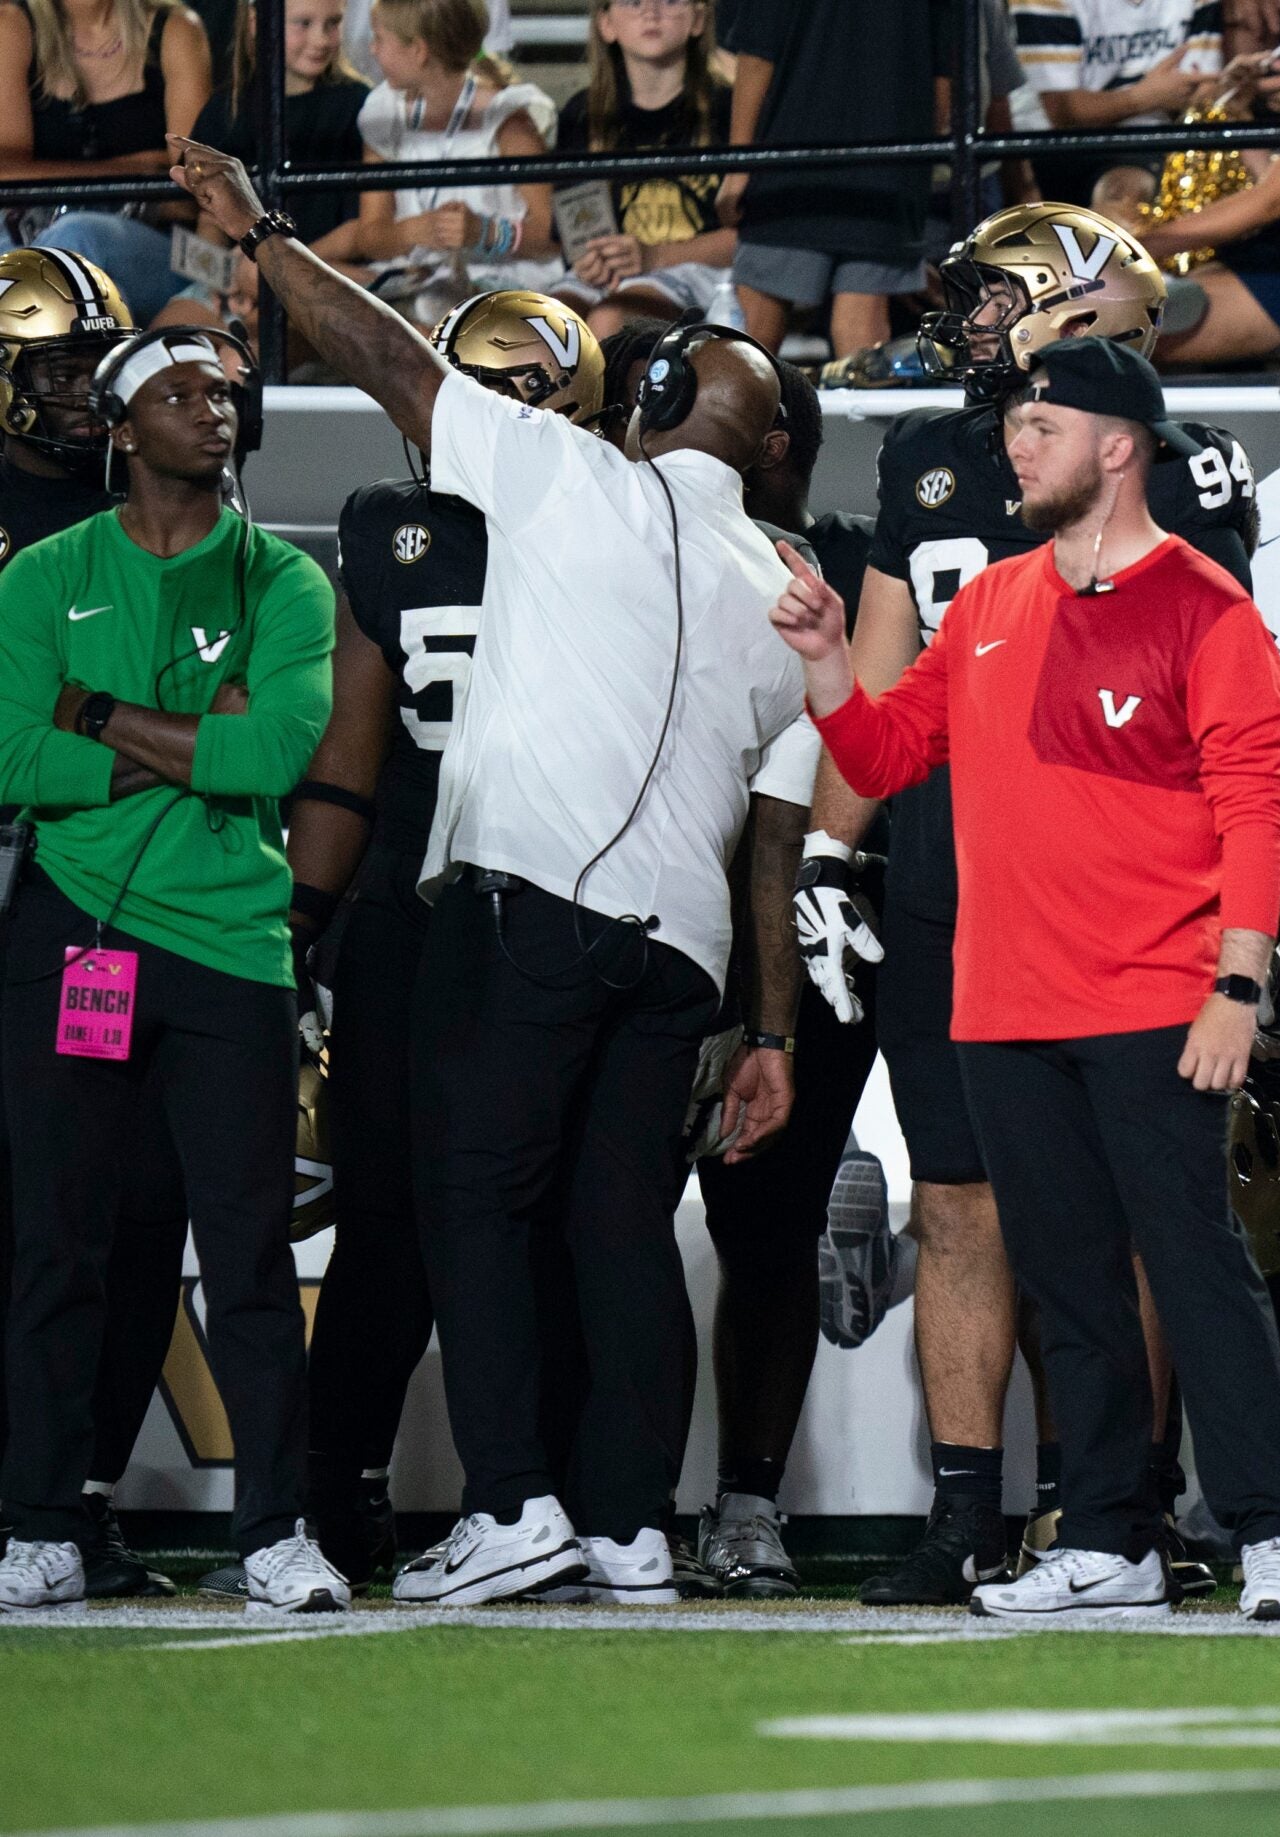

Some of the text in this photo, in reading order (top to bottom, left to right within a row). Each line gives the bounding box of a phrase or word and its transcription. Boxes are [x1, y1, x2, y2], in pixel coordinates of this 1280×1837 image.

[1052, 223, 1117, 280] V
[81, 316, 115, 331] VUFB
[524, 315, 577, 368] V
[918, 470, 952, 505] SEC
[1187, 441, 1256, 509] 94
[1005, 500, 1022, 515] V
[395, 526, 428, 561] SEC
[191, 627, 232, 663] V
[1098, 688, 1142, 728] V
[65, 986, 130, 1015] BENCH
